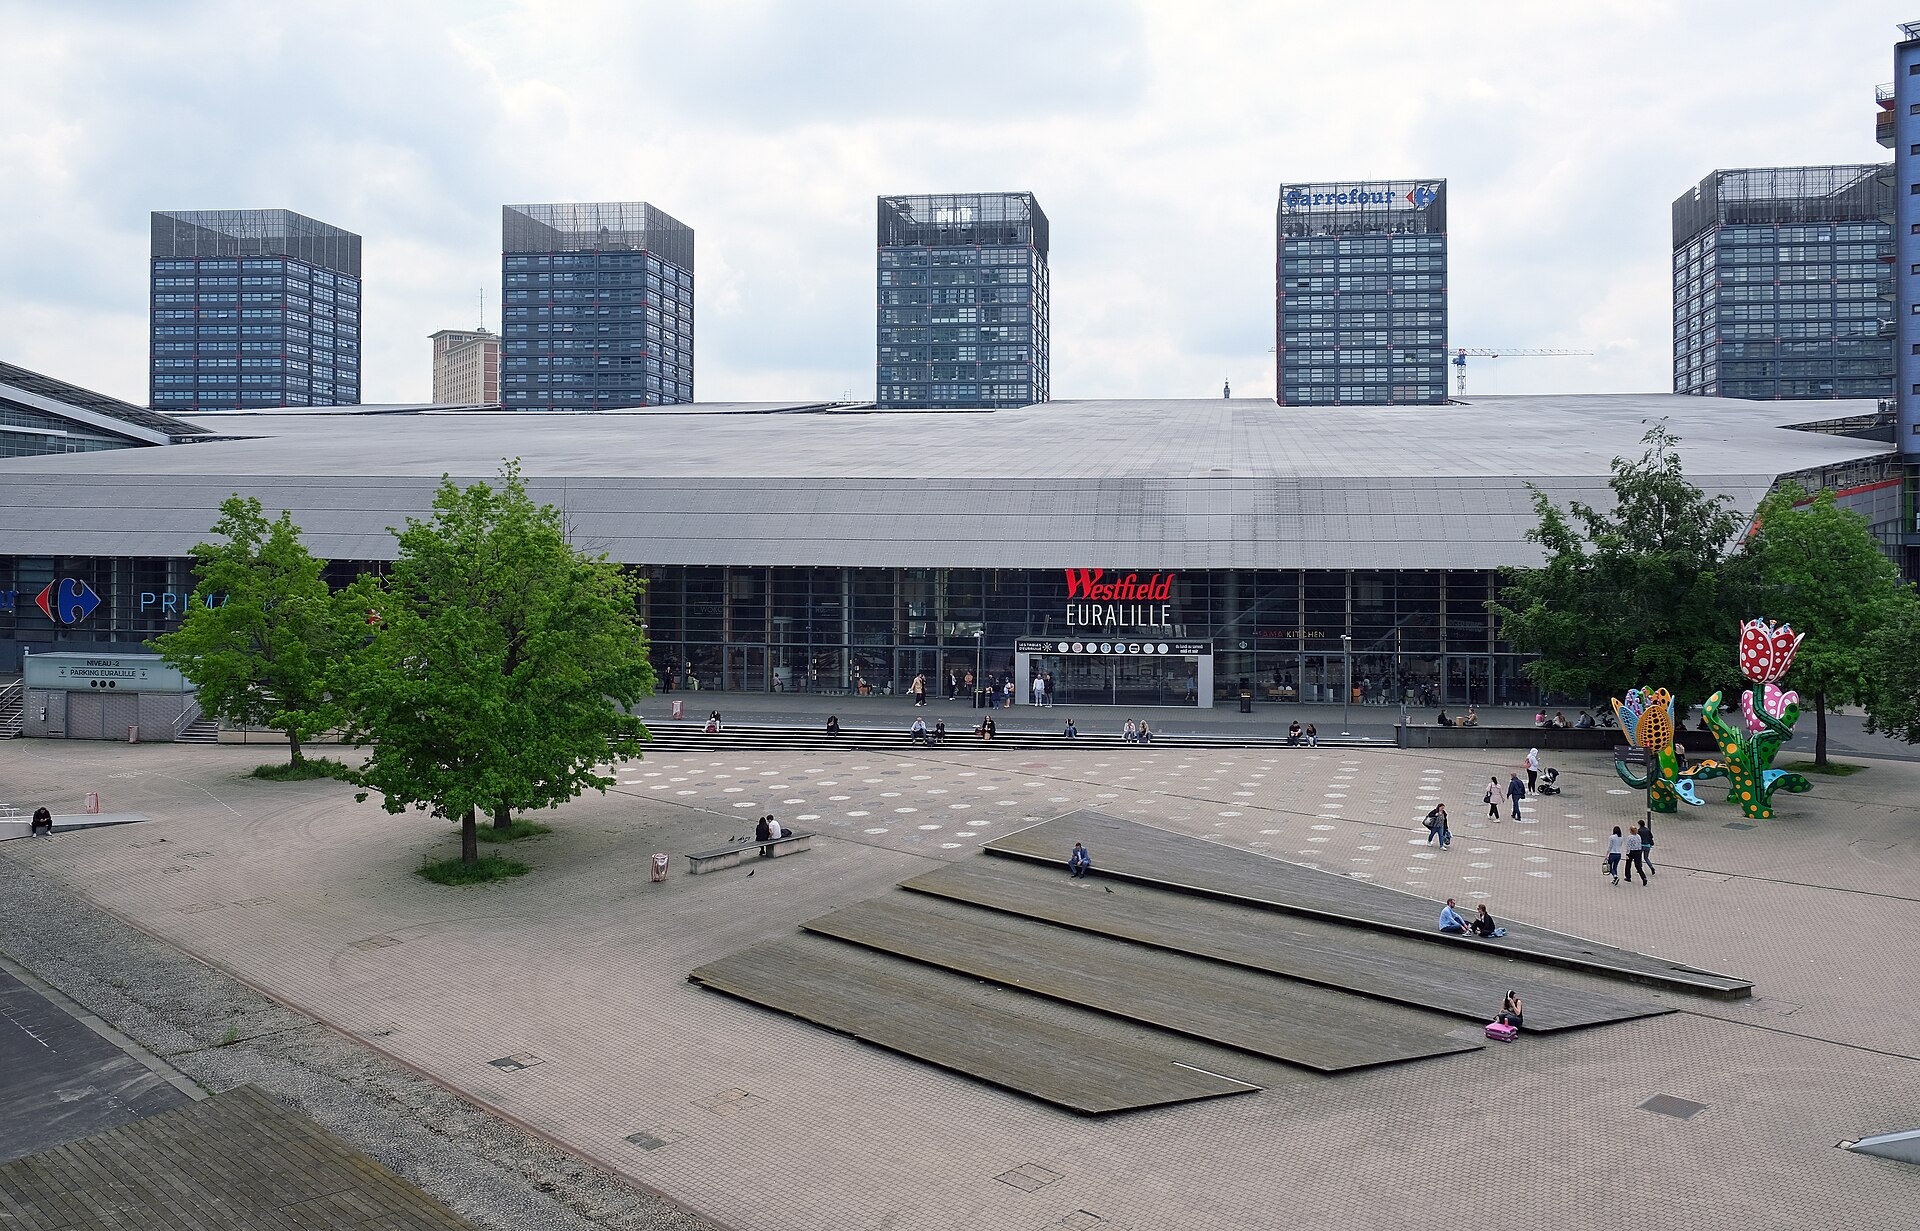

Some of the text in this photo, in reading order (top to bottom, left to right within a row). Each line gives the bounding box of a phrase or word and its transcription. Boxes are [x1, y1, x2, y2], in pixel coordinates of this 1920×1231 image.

[1285, 188, 1396, 207] Carrefour
[1065, 568, 1176, 601] Westfield
[1066, 603, 1171, 627] EURALILLE
[100, 669, 136, 677] EURALILLE
